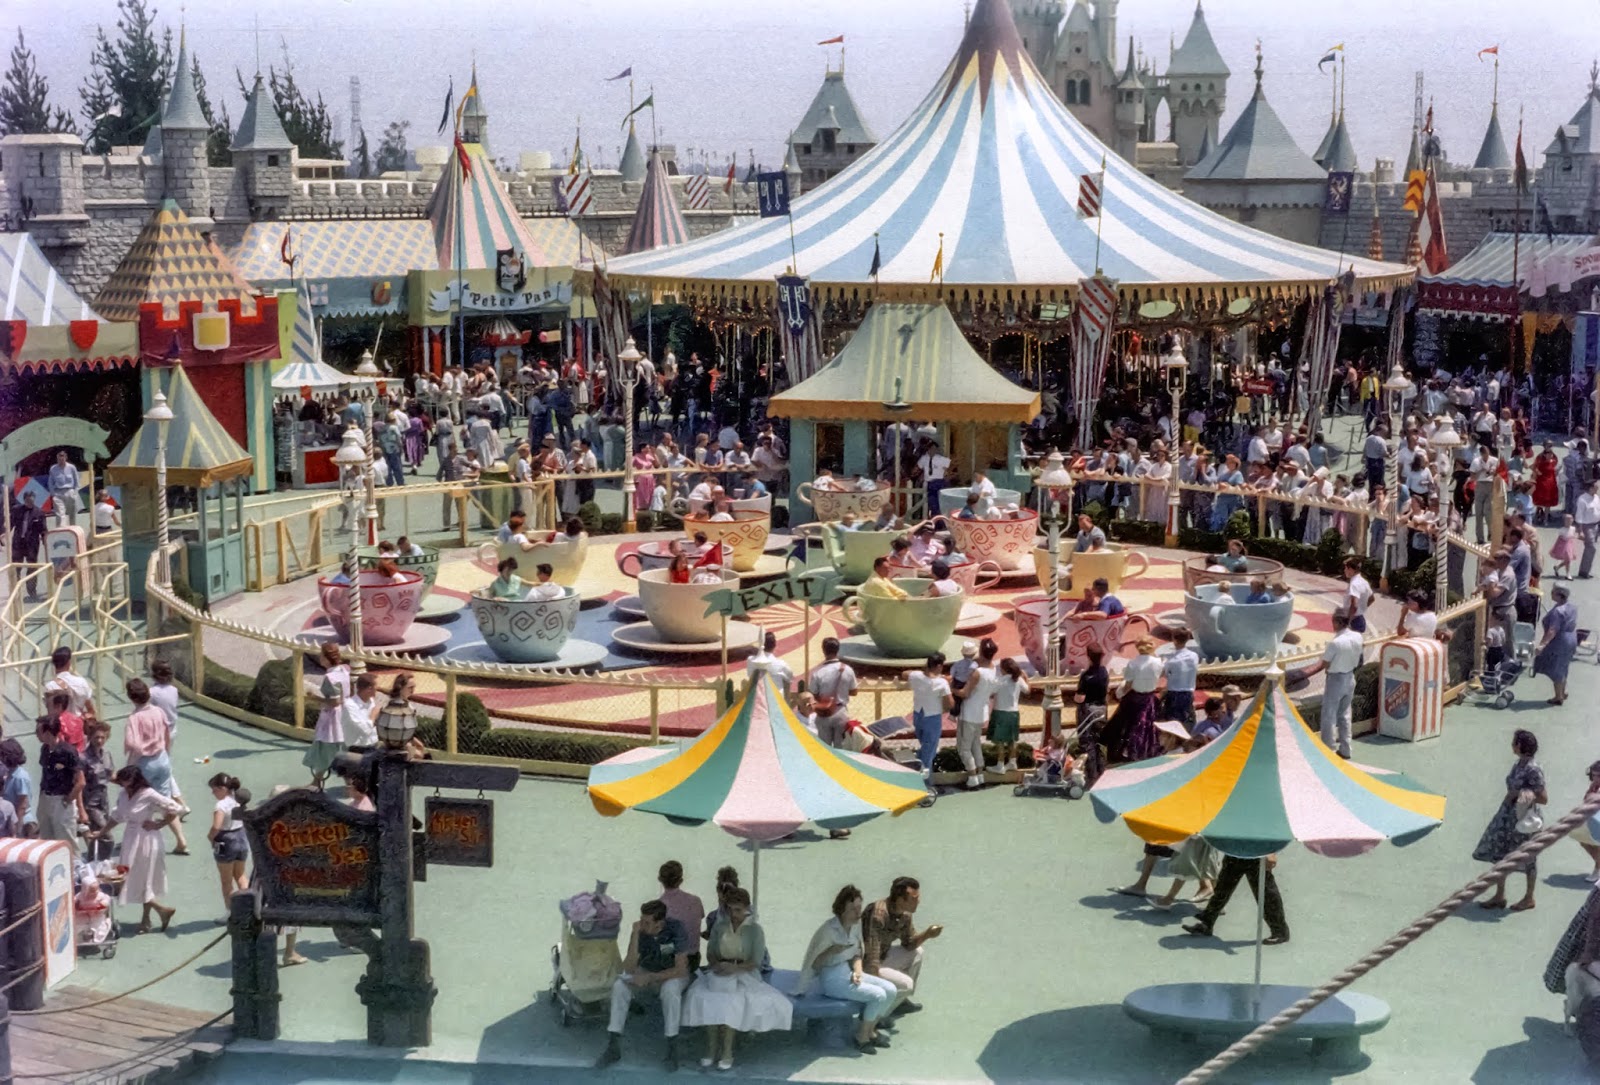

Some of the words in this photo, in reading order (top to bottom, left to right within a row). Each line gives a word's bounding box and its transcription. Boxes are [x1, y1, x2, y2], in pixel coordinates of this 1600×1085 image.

[470, 291, 515, 307] Peter
[522, 288, 552, 305] Pan
[737, 577, 815, 612] EXIT
[327, 842, 369, 867] Sea
